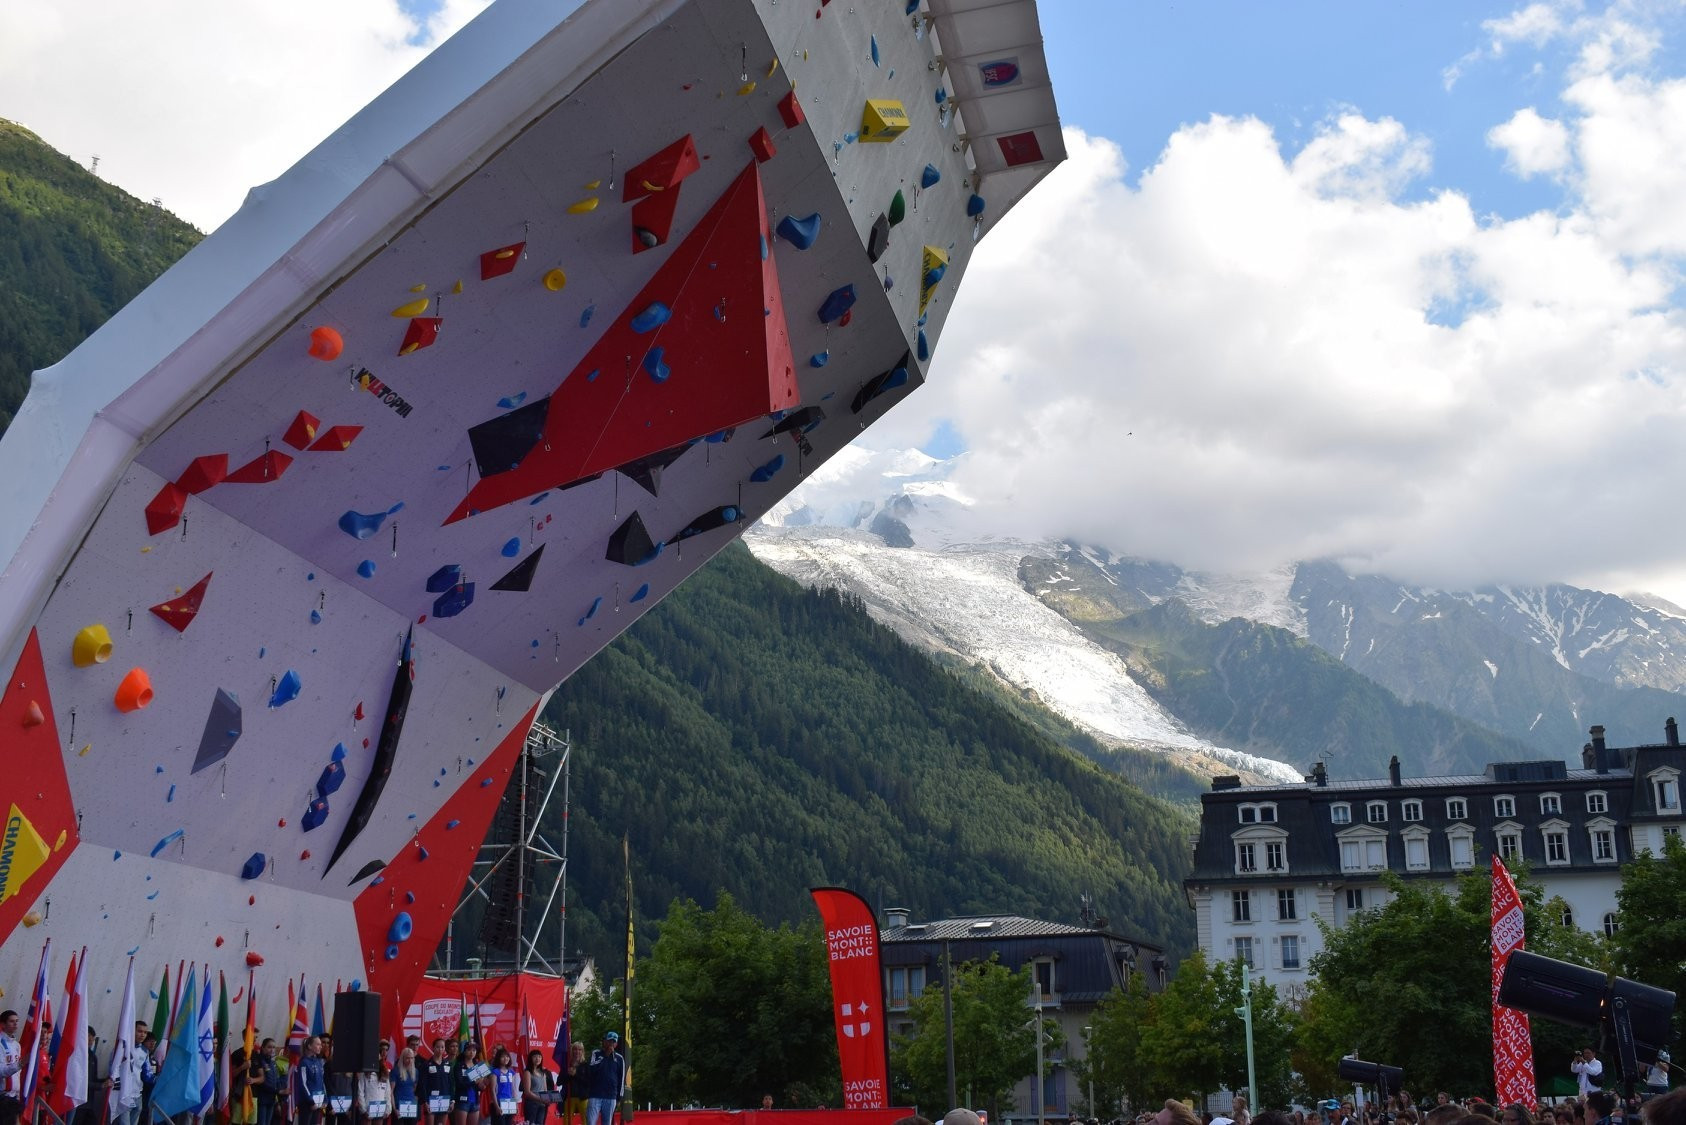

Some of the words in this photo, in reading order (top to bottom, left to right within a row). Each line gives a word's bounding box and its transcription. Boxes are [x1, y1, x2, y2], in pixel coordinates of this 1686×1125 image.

[1493, 910, 1520, 936] SAVOIE
[828, 924, 872, 940] SAVOIE
[1496, 921, 1518, 944] MONT
[829, 936, 865, 951] MONT
[831, 946, 873, 960] BLANC
[845, 1079, 881, 1091] SAVOIE
[846, 1090, 877, 1102] MONT
